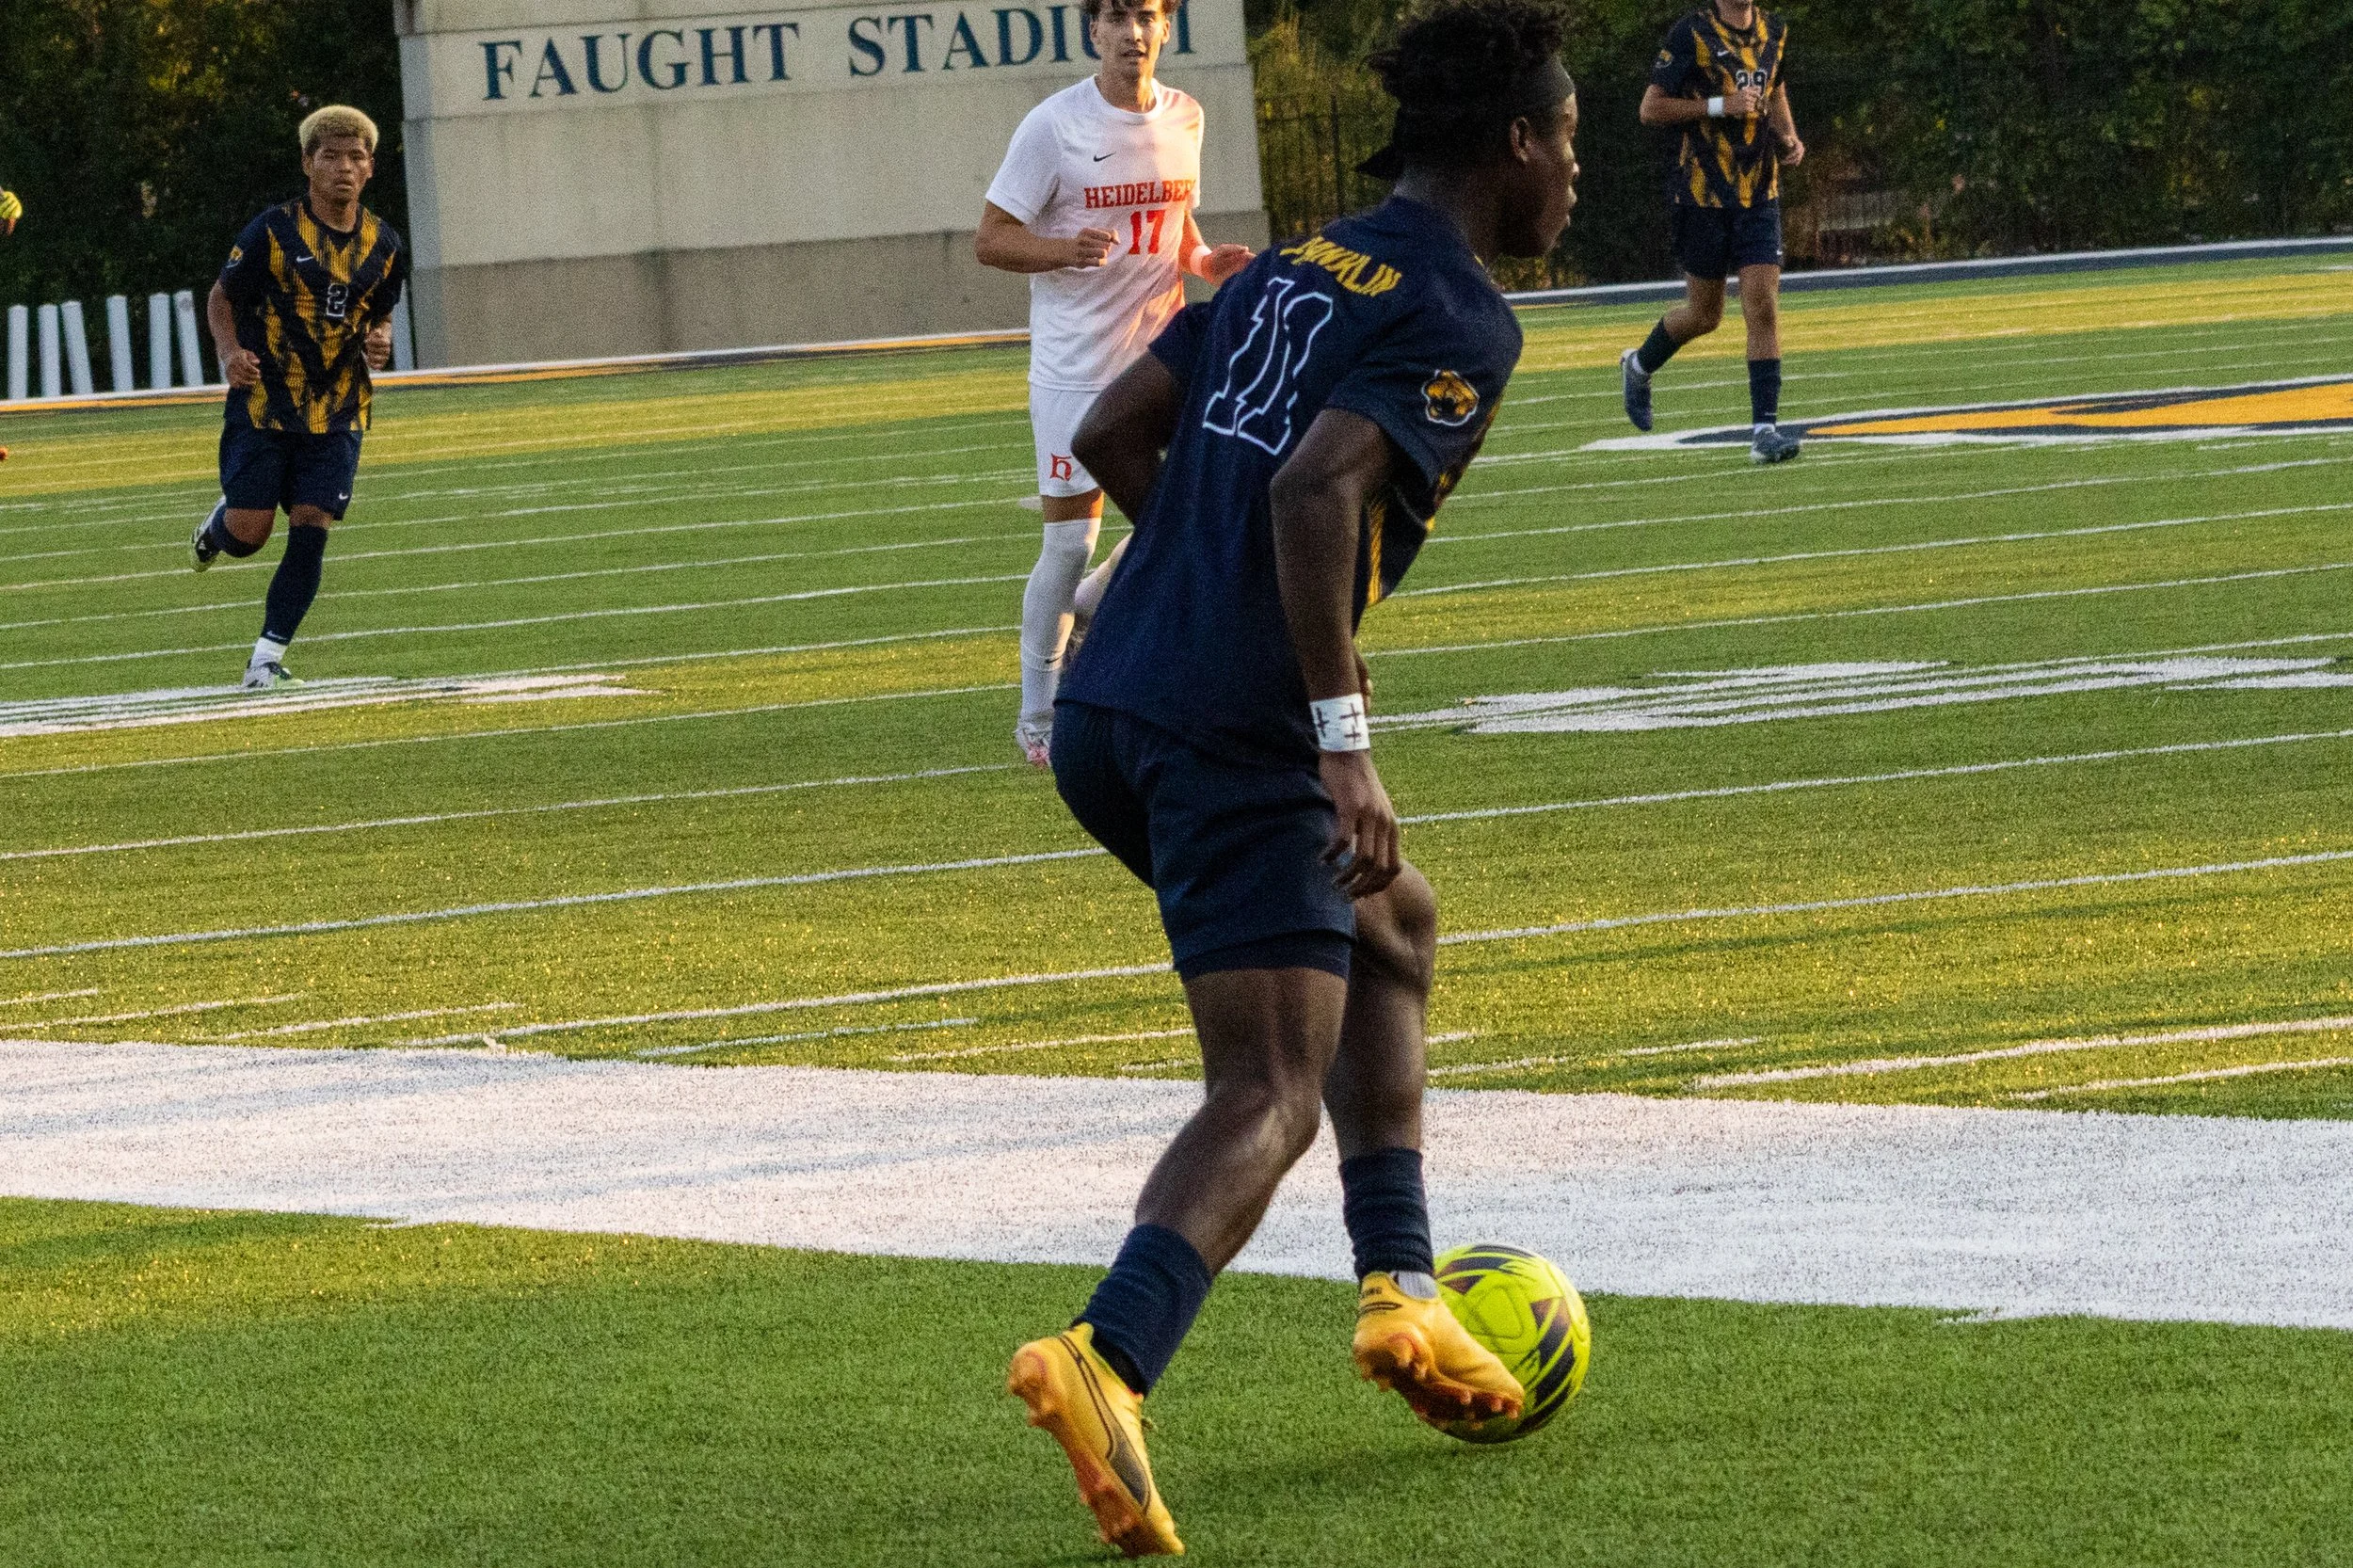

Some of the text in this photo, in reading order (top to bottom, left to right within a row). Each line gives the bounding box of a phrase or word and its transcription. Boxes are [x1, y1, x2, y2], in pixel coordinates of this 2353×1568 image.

[477, 0, 1195, 101] FAUGHT STADI
[1128, 210, 1166, 255] 17
[326, 281, 349, 318] 2
